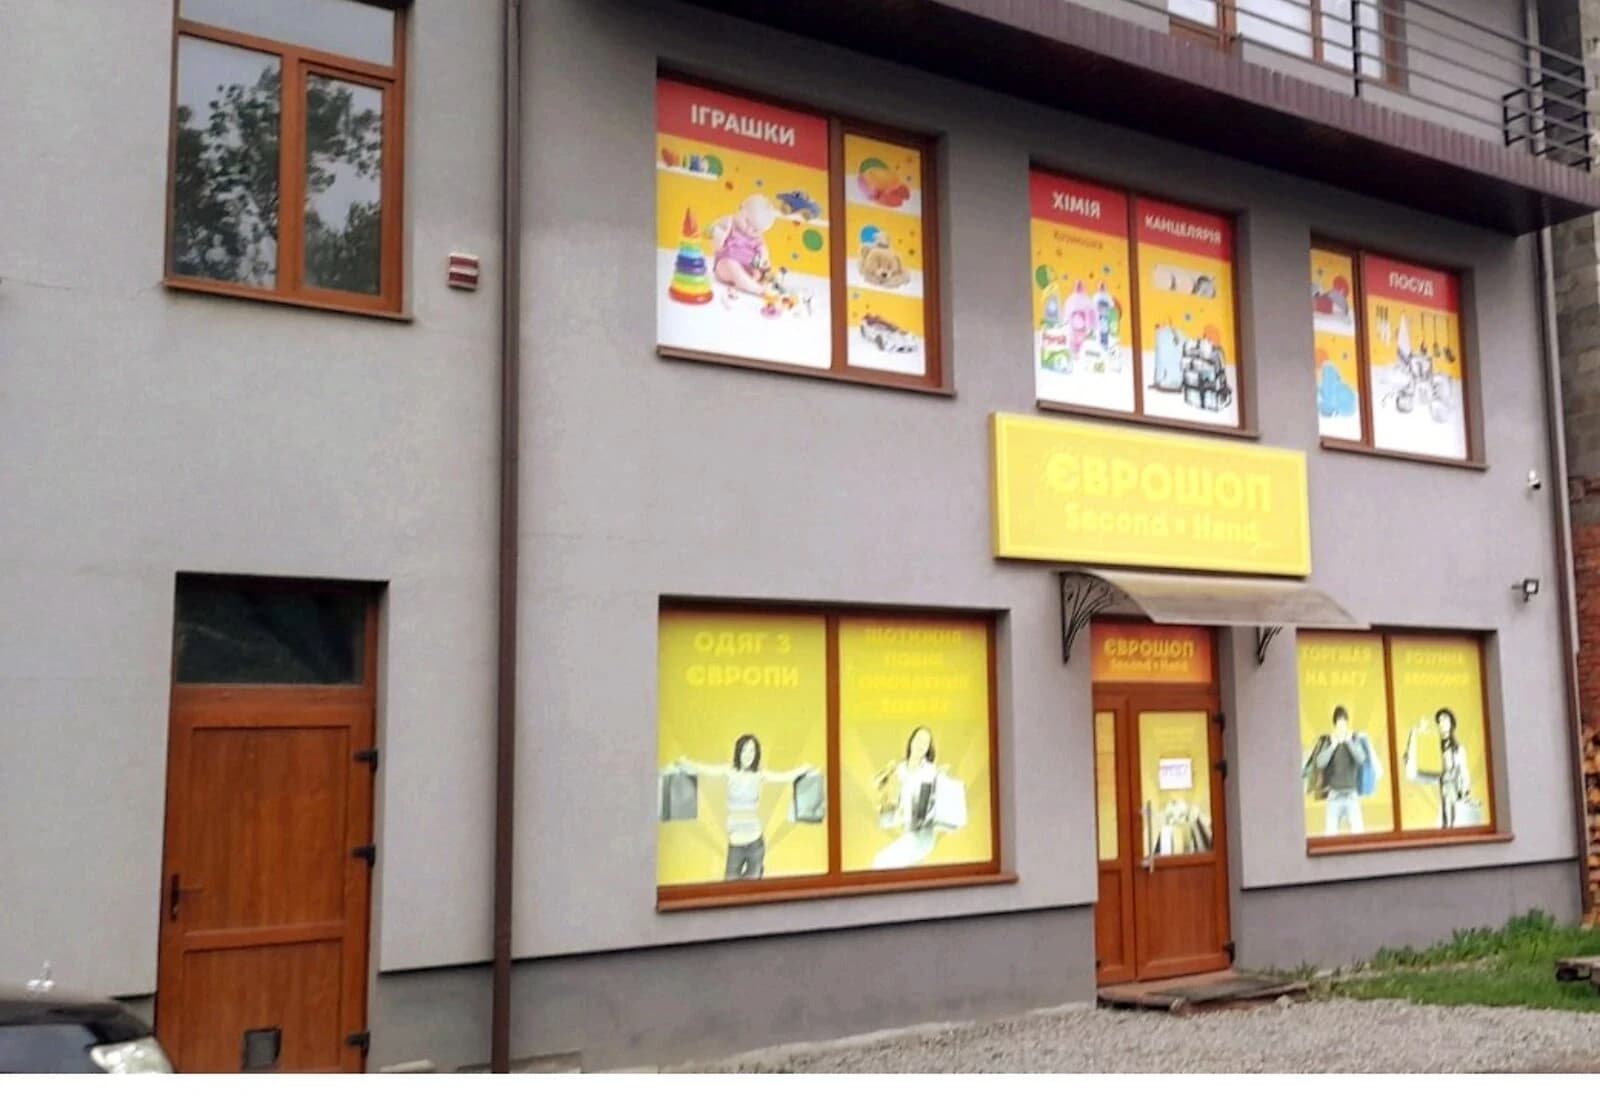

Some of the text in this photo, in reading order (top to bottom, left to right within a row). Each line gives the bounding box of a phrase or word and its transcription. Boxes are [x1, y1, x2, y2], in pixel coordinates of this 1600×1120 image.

[690, 103, 796, 147] ІГРАШКИ
[1052, 191, 1101, 220] ХІМІЯ
[1144, 213, 1222, 246] КАНЦЕЛЯРІЯ
[1388, 271, 1435, 298] ПОСУД
[1045, 452, 1273, 513] ЄВРОШОП
[1063, 503, 1262, 545] Second Hand
[693, 631, 768, 657] ОДЯГ
[1103, 638, 1195, 658] ЄВРОШОП
[685, 664, 800, 688] ЄВРОПИ
